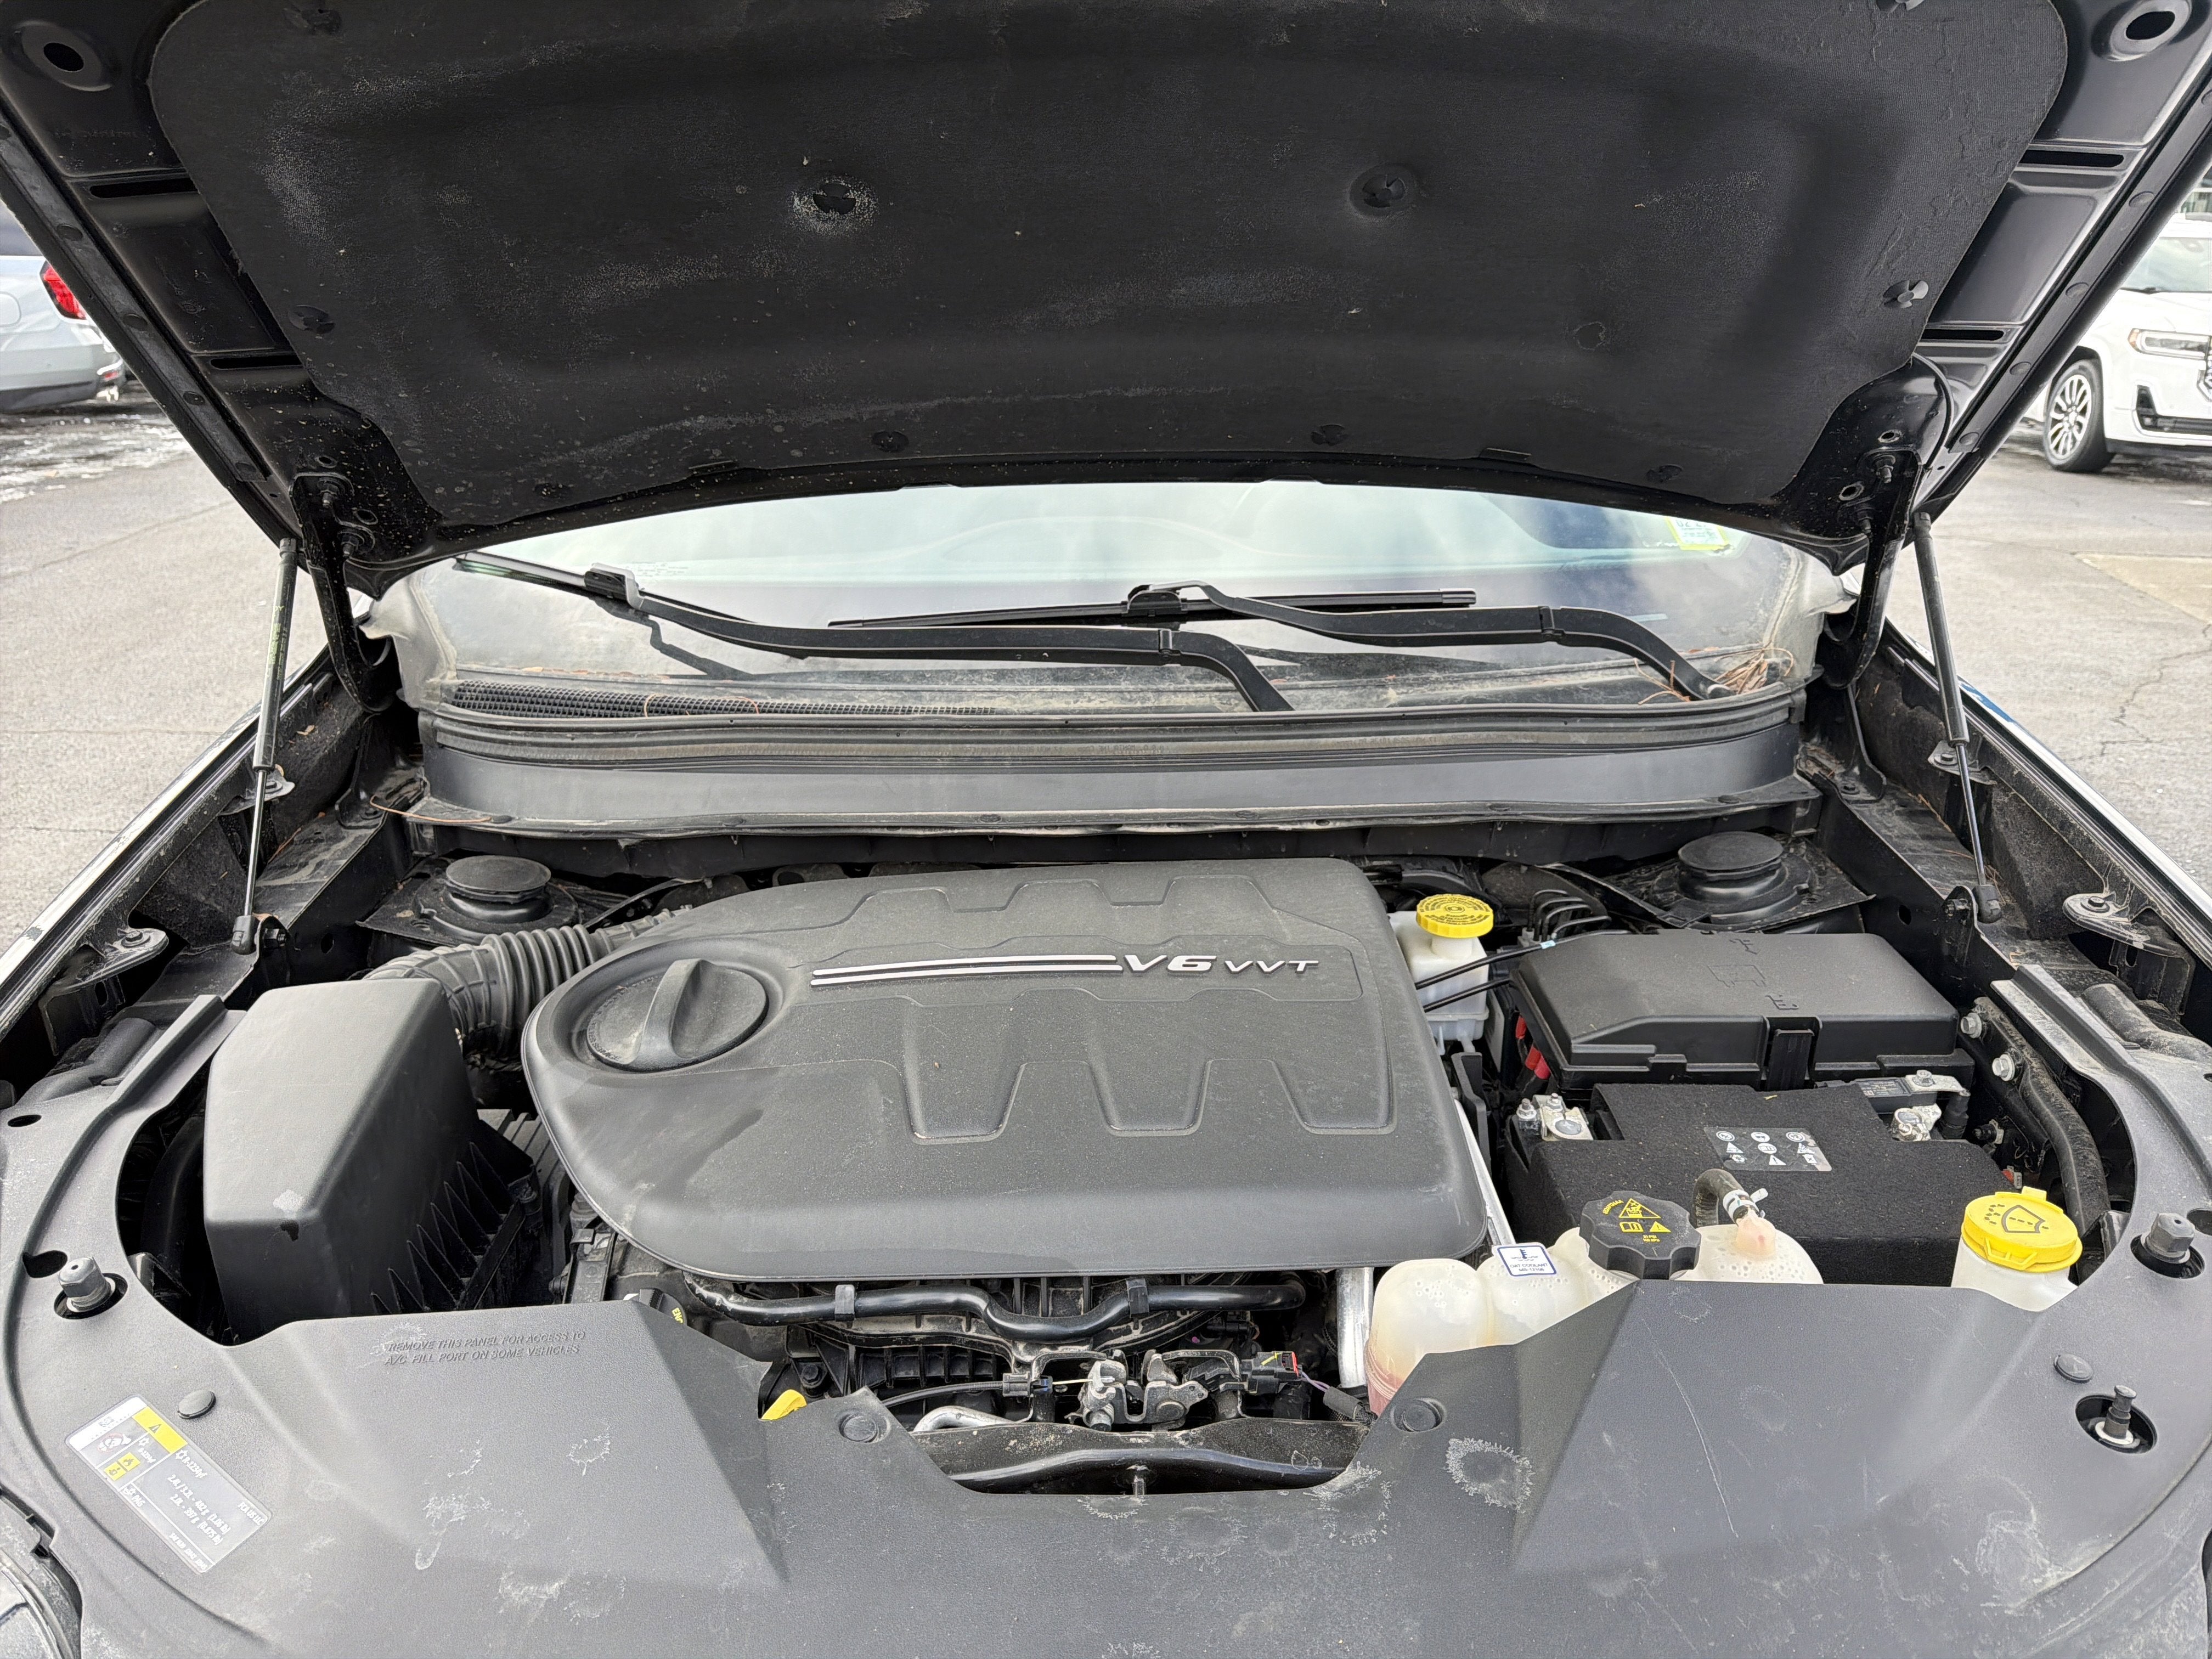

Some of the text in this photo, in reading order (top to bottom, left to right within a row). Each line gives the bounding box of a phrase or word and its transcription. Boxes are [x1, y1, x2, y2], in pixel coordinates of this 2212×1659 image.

[1124, 955, 1319, 974] V6 VVT
[387, 1330, 586, 1352] REMOVE THIS PANEL FOR ACCESS TO
[384, 1344, 580, 1365] A/C FILL PORT ON SOME VEHICLES
[182, 1457, 207, 1478] R-1234yf
[131, 1495, 145, 1507] PAG
[238, 1502, 264, 1525] FCA US LLC
